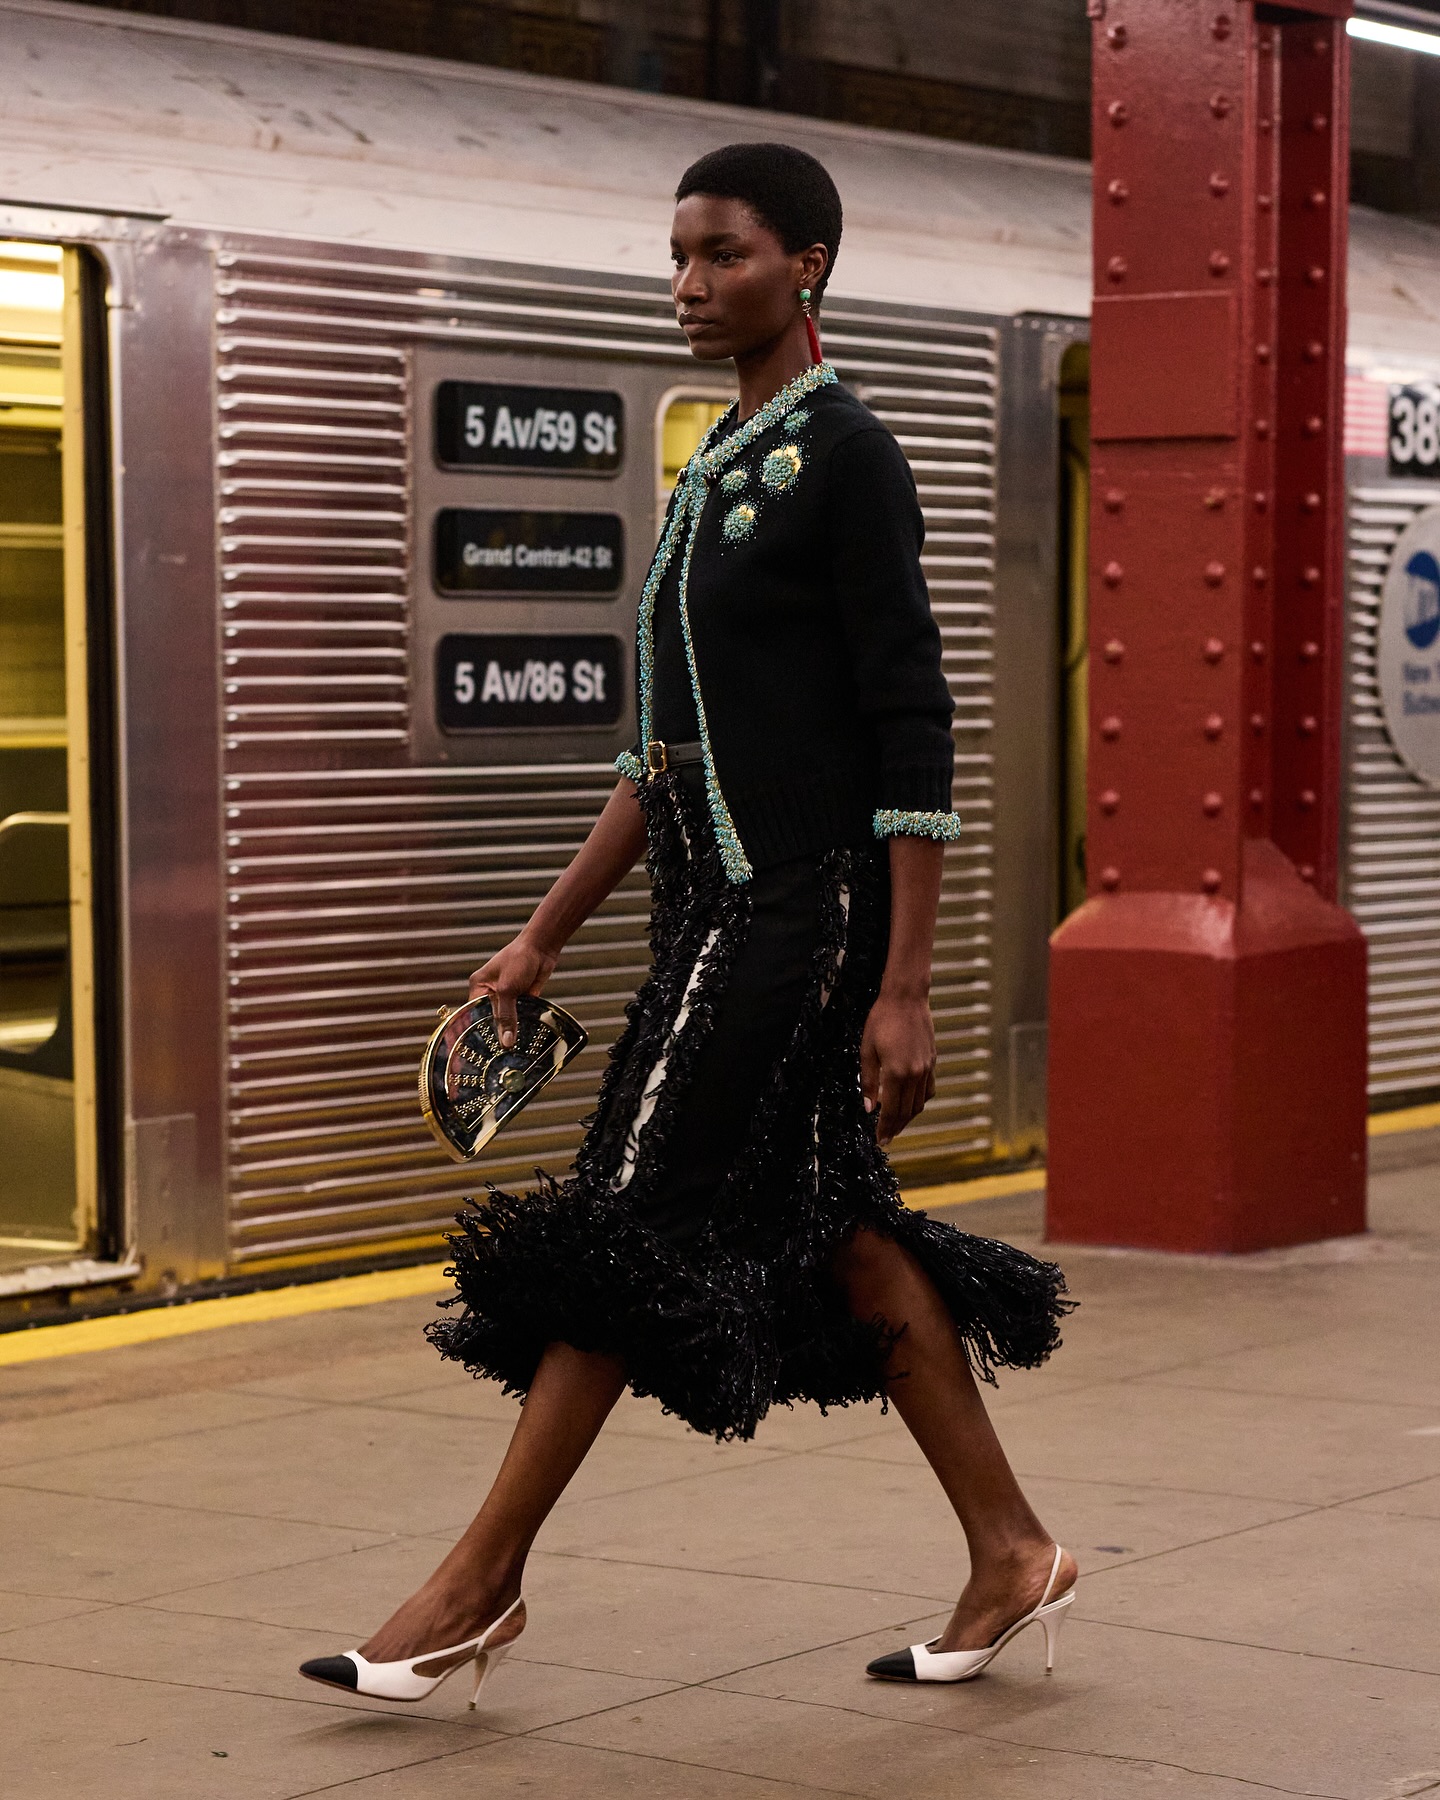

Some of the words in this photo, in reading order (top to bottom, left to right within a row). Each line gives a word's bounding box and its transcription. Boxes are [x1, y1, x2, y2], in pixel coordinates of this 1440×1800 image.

[465, 405, 485, 447] 5
[491, 406, 577, 453] Av/59
[583, 411, 616, 455] St
[1391, 396, 1440, 465] 38
[463, 542, 513, 567] Grand
[515, 543, 592, 568] Central-42
[595, 545, 612, 569] St
[455, 661, 474, 704] 5
[481, 659, 566, 703] Av/86
[572, 659, 605, 703] St
